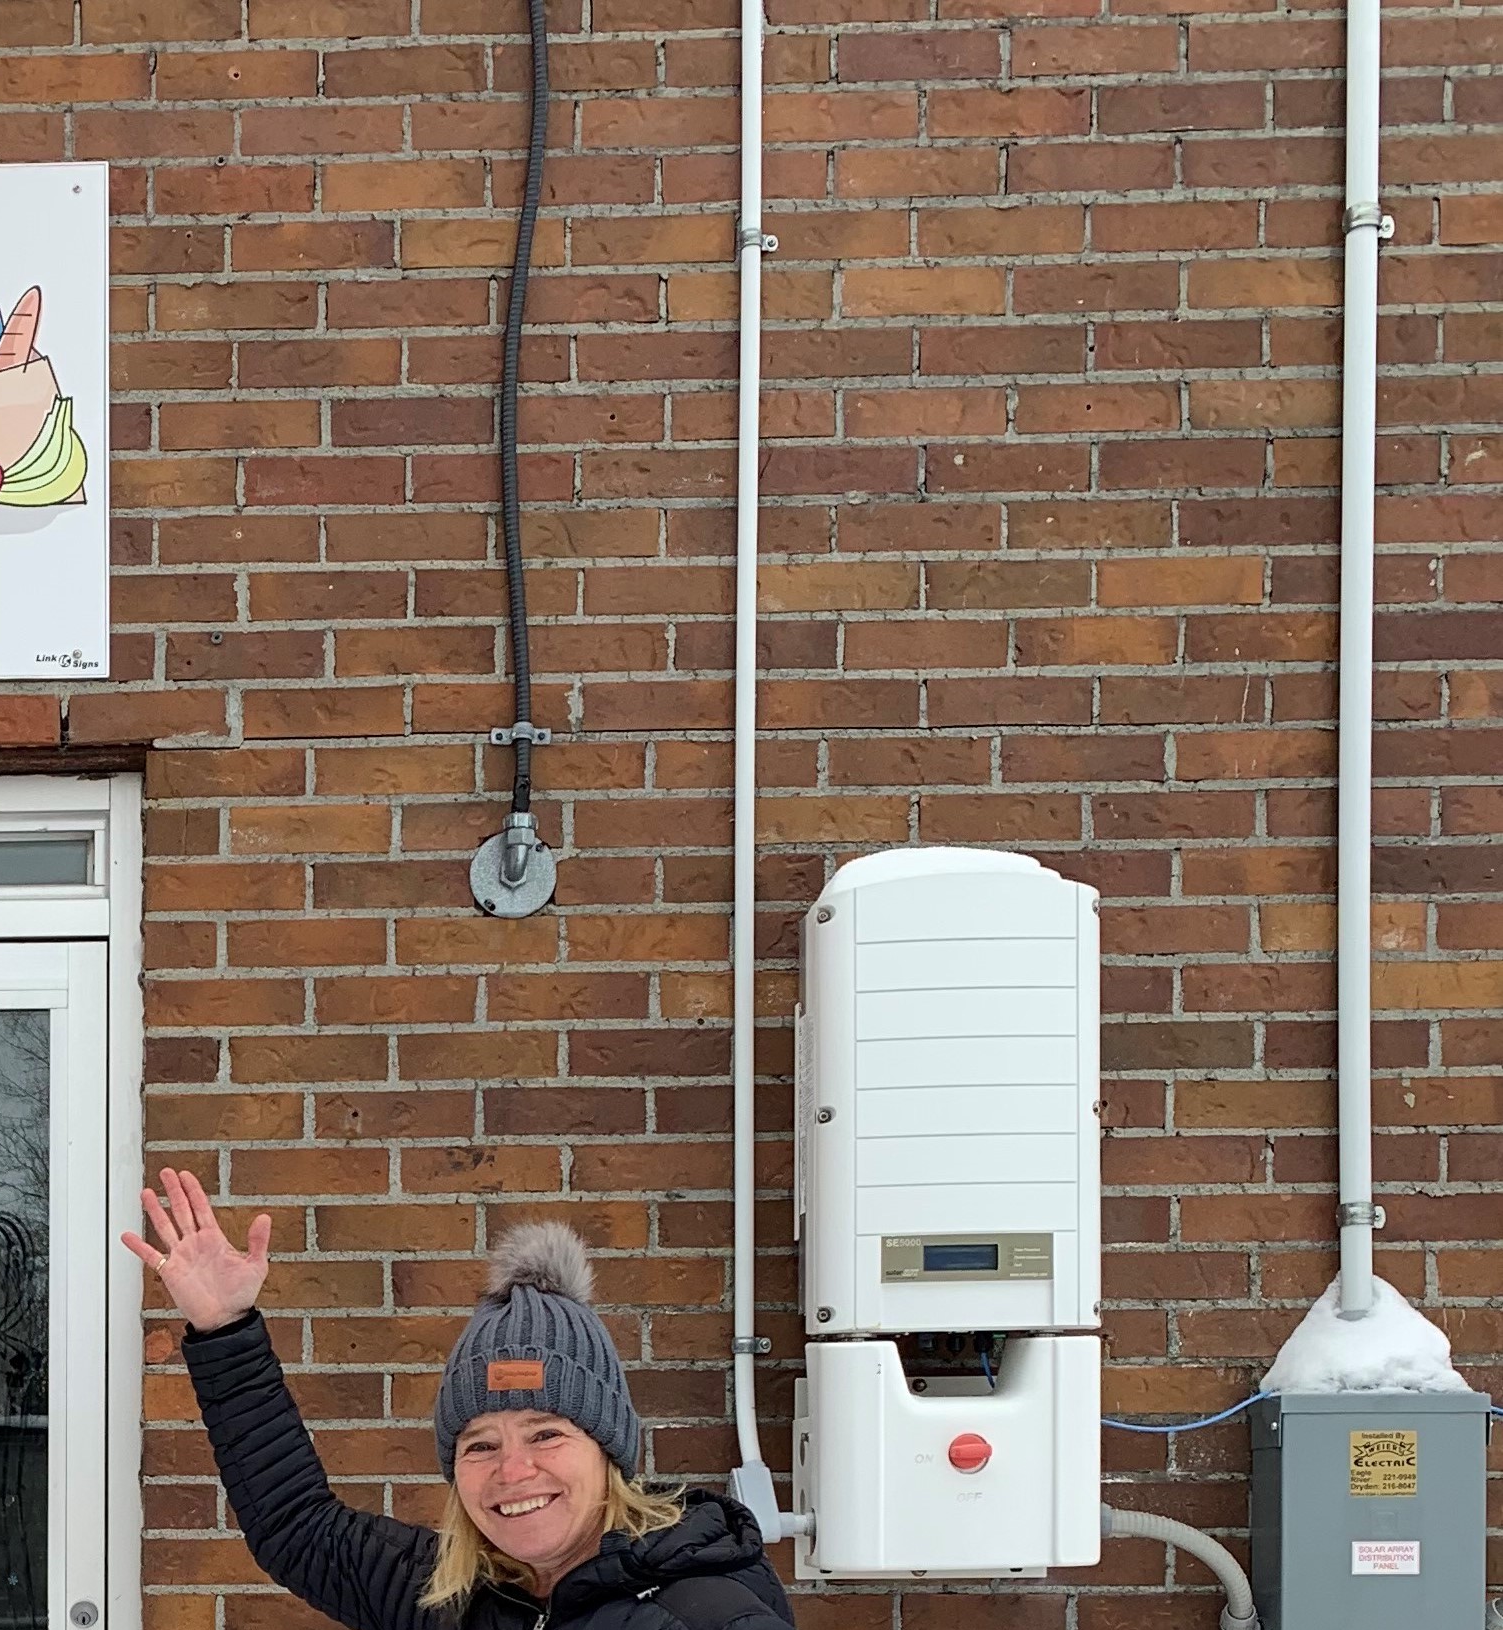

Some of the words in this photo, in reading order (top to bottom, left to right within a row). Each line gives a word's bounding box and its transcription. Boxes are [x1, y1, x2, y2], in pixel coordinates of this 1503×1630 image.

[35, 654, 58, 662] Link
[72, 660, 99, 669] Signs
[1395, 1432, 1406, 1440] By
[914, 1453, 934, 1464] ON
[1358, 1545, 1386, 1553] SOLAR
[1387, 1545, 1415, 1553] ARRAY
[1358, 1554, 1414, 1562] DISTRIBUTION
[1373, 1562, 1400, 1570] PANEL
